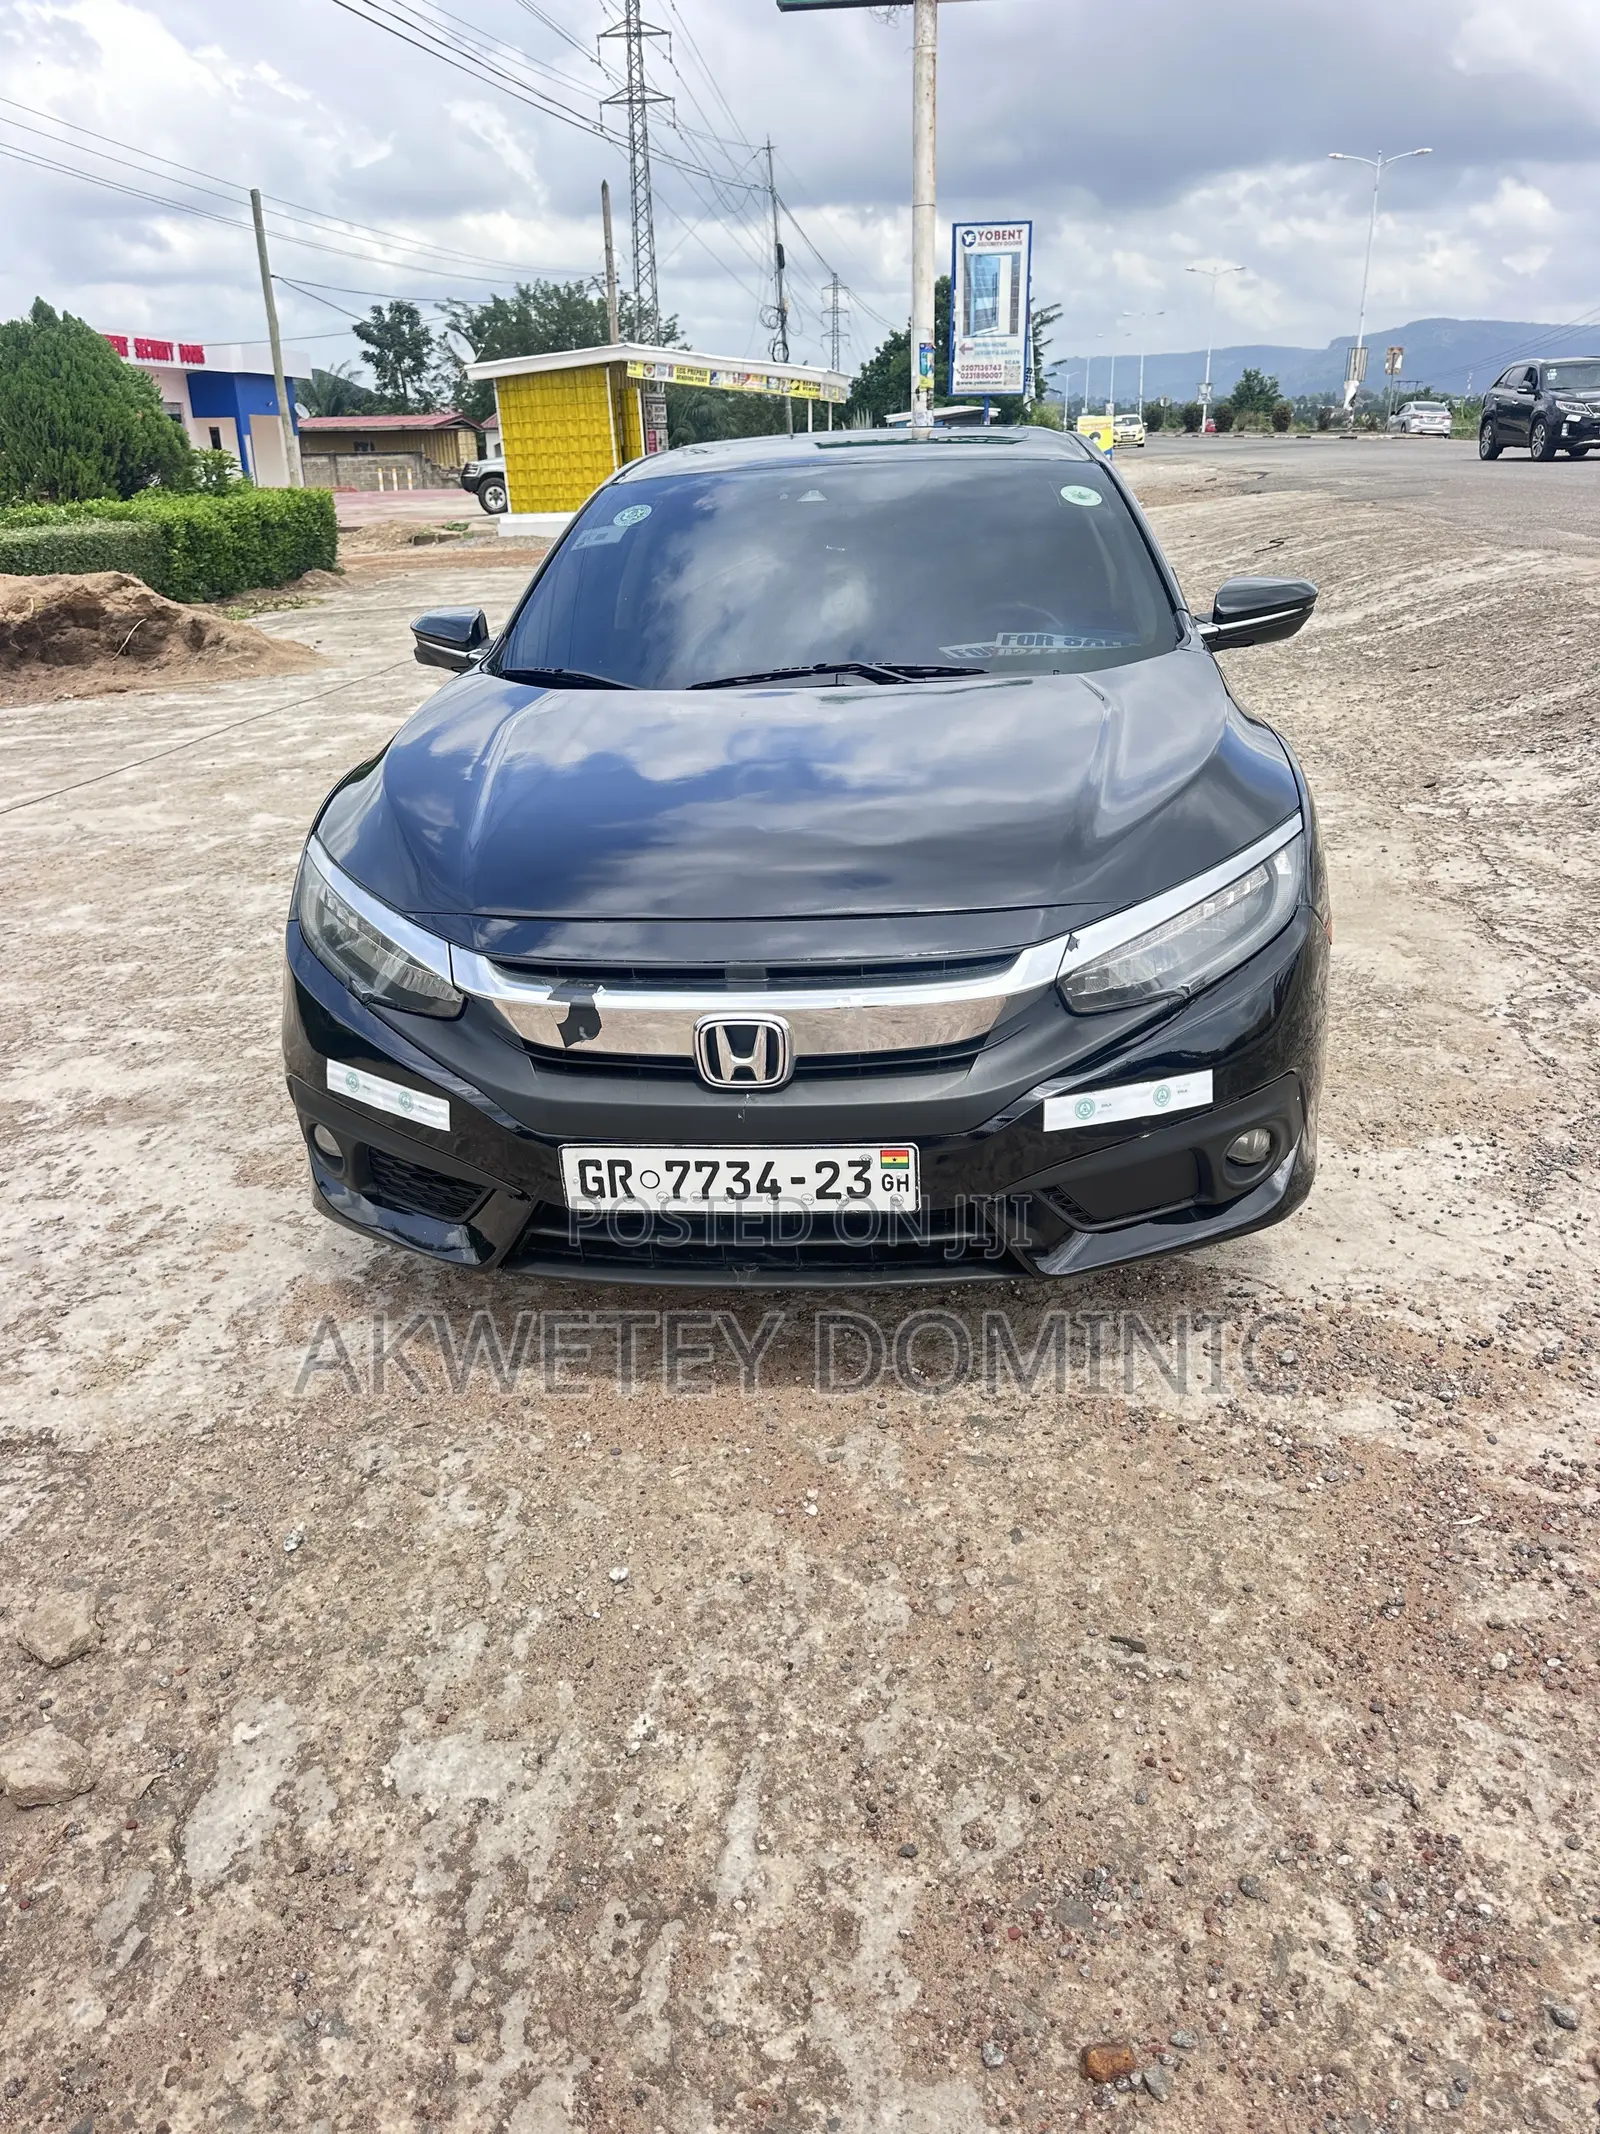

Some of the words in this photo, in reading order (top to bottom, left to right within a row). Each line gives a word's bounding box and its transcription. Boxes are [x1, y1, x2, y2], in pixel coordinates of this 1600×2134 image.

[977, 229, 1023, 241] YOBENT
[1001, 634, 1054, 646] FOR
[577, 1159, 633, 1199] GR
[664, 1160, 872, 1200] 7734-23
[881, 1173, 909, 1193] GH
